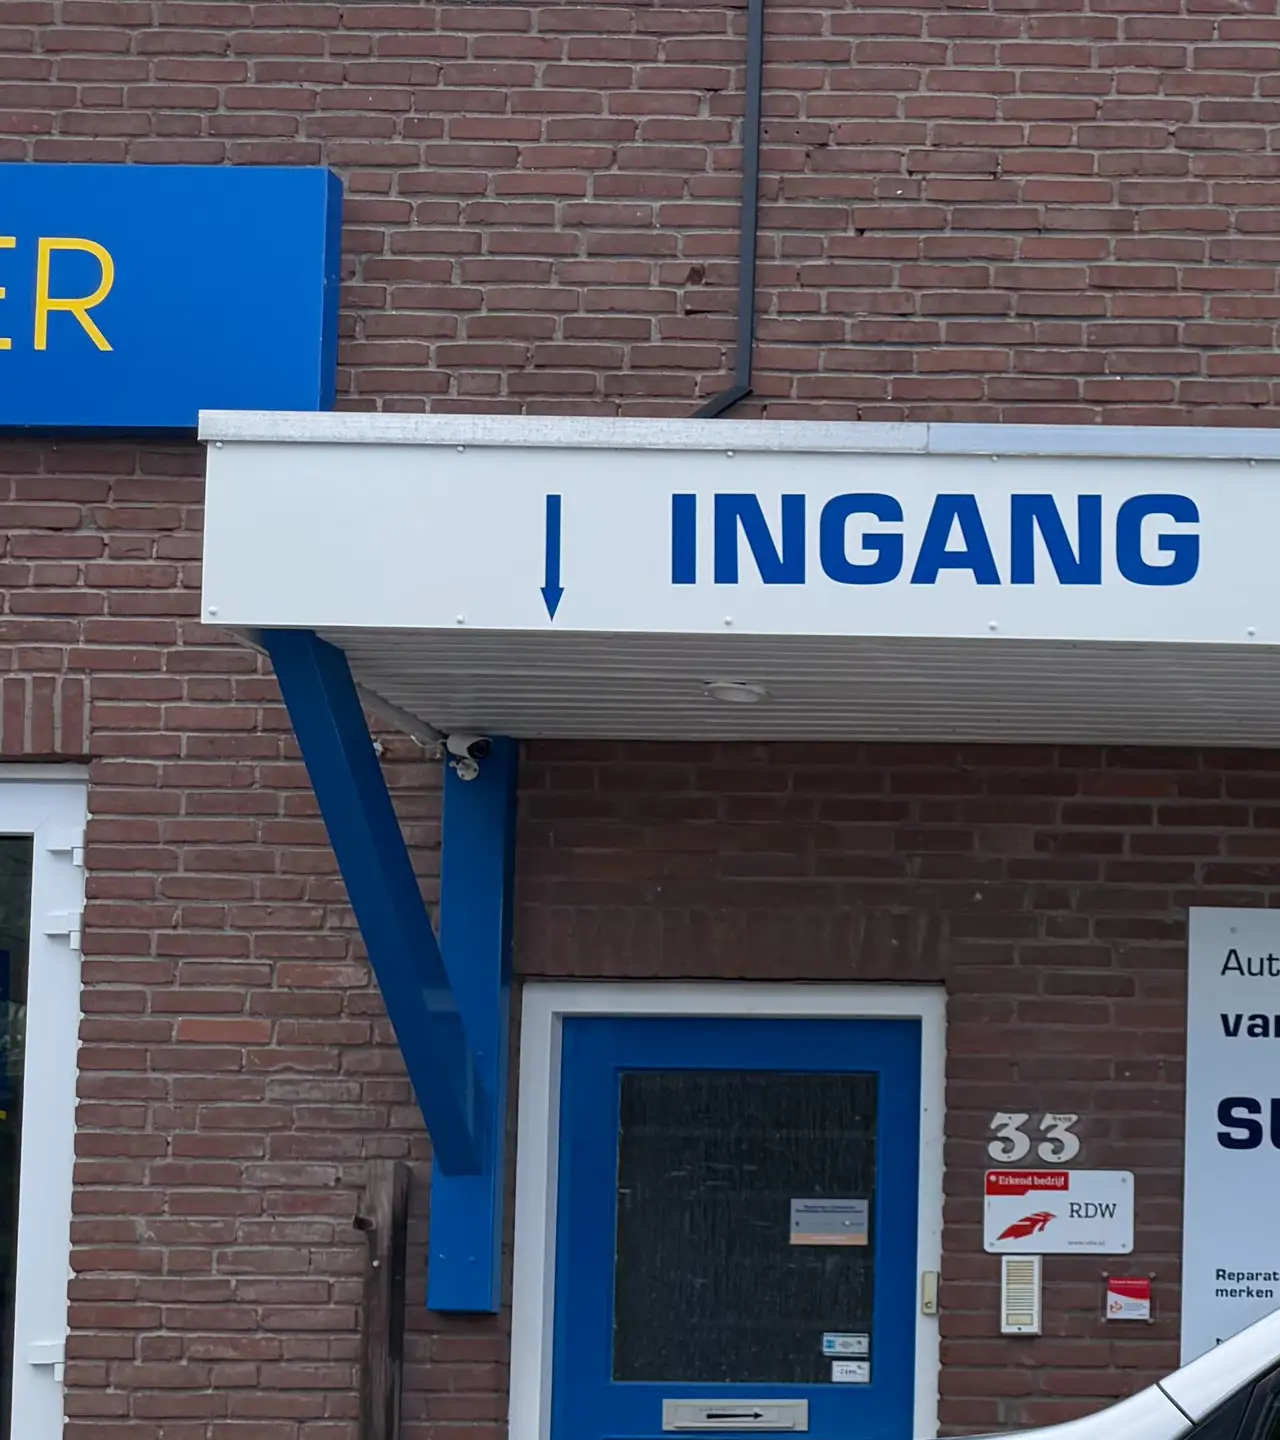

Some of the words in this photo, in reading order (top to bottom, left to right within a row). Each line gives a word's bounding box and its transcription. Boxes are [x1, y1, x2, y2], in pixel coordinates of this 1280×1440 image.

[672, 493, 1200, 585] INGANG
[988, 1112, 1080, 1163] 33
[999, 1174, 1033, 1186] Erkend
[1034, 1175, 1065, 1188] bedrijf
[1069, 1202, 1117, 1218] RDW
[1215, 1286, 1273, 1298] merken
